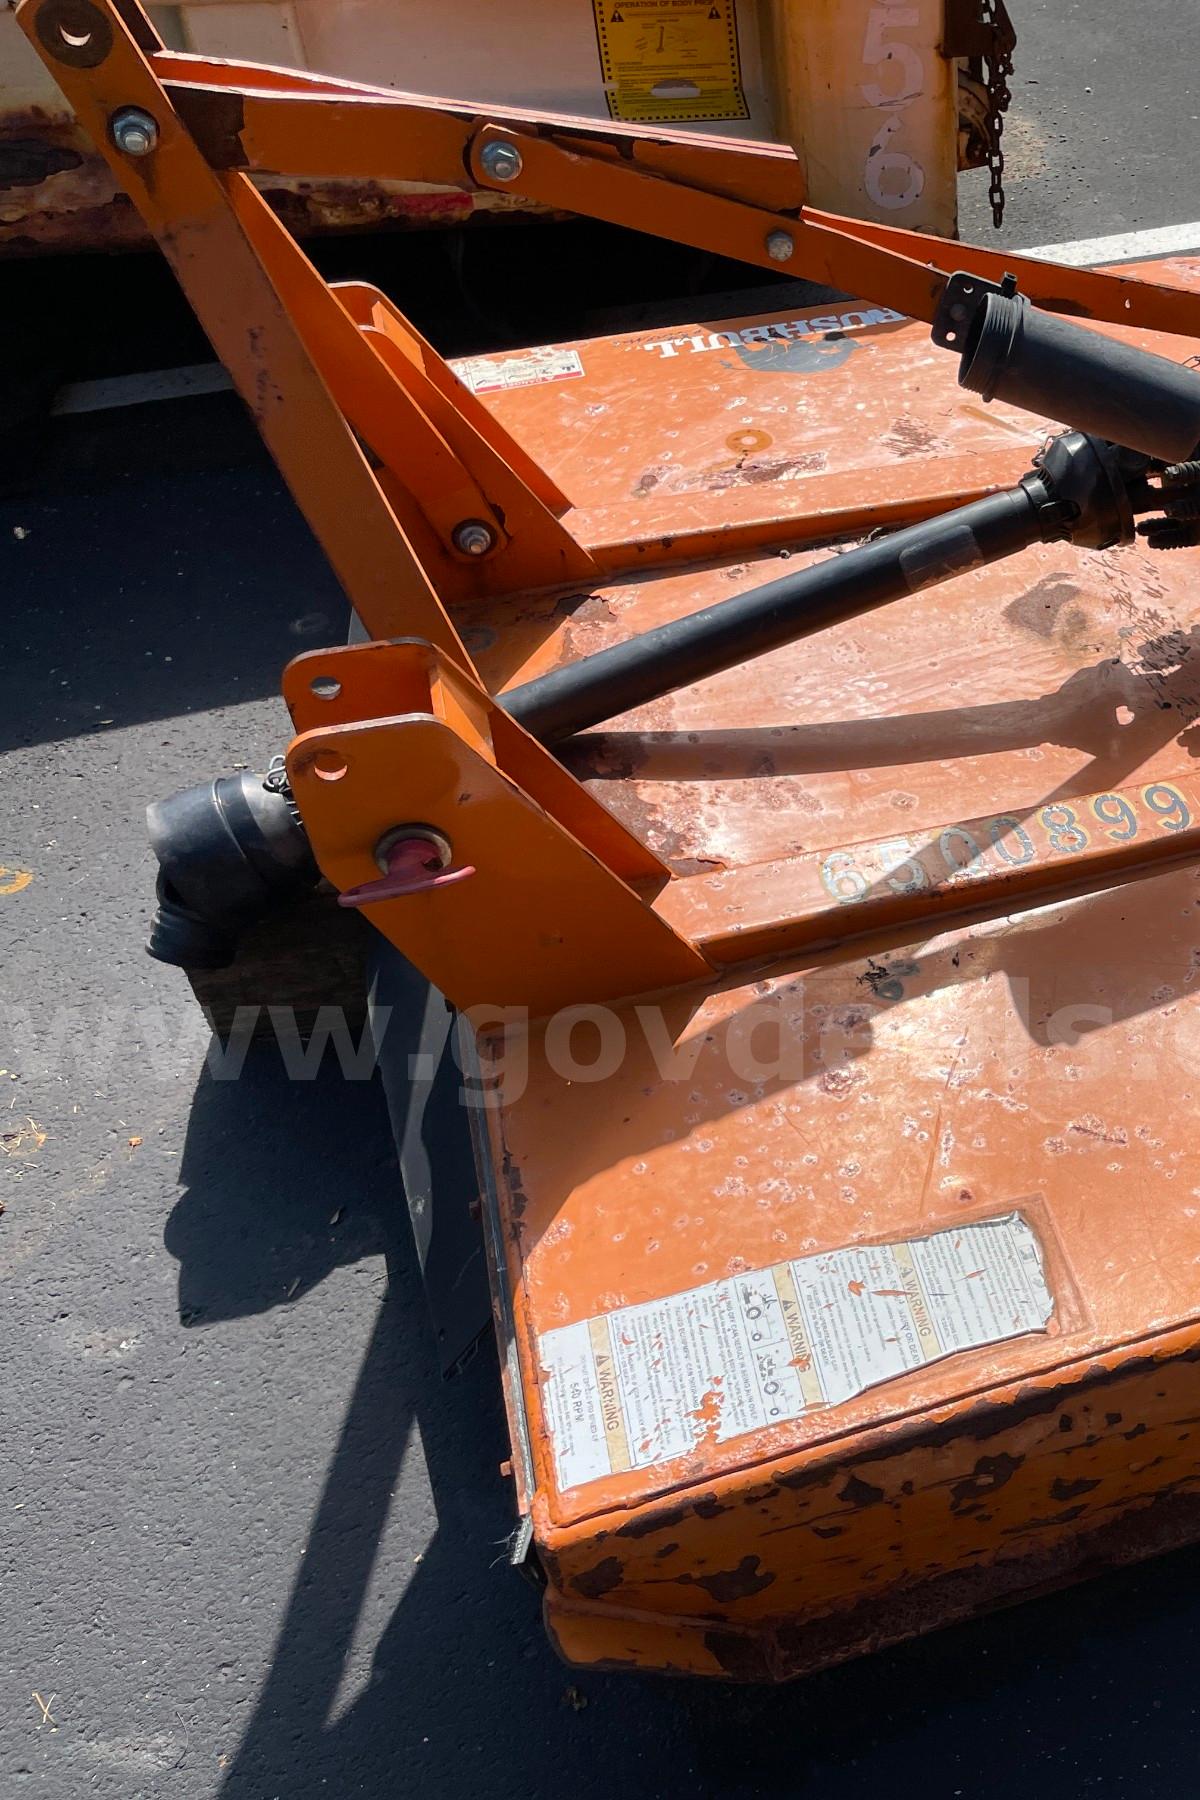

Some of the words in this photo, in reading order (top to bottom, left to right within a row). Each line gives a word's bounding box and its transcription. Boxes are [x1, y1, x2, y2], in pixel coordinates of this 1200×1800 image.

[820, 783, 1193, 905] 6500899
[905, 1280, 932, 1337] WARNING
[786, 1313, 812, 1373] WARNING
[568, 1381, 581, 1399] 540
[572, 1399, 586, 1422] RPM
[599, 1367, 620, 1431] WARNING
